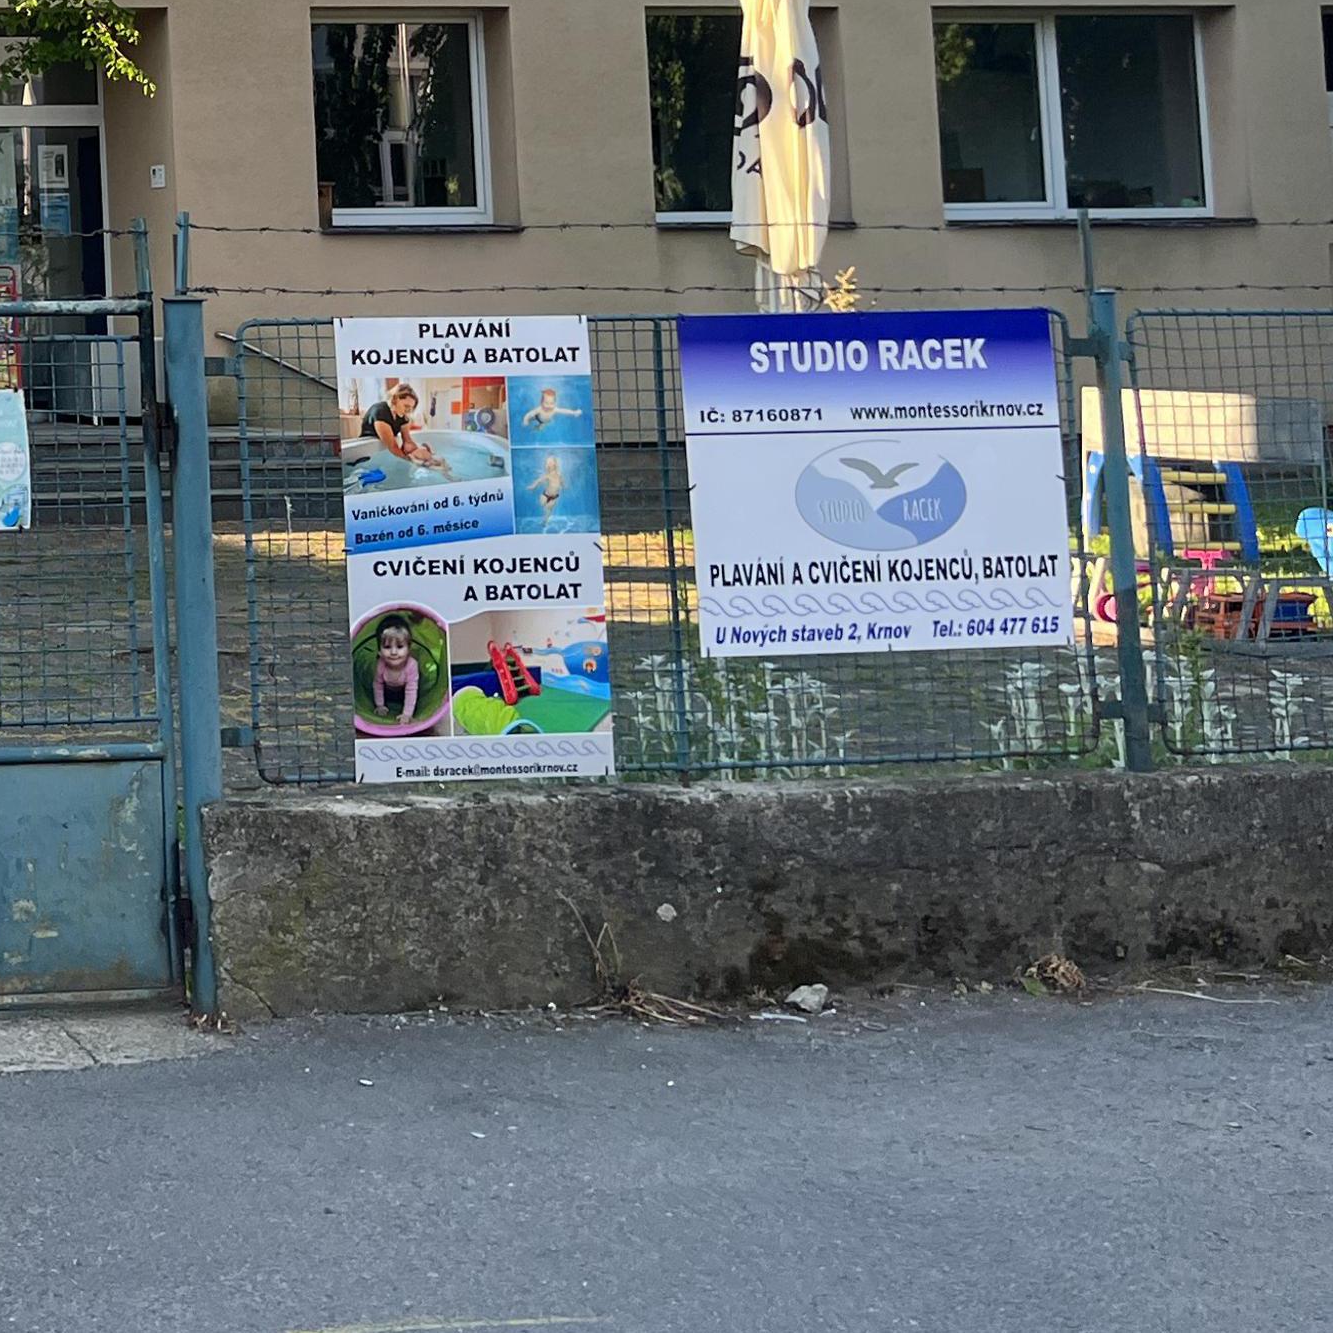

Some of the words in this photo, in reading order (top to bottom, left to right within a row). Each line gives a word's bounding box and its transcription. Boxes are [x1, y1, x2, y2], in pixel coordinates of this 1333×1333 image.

[418, 318, 511, 338] PLAVÁNÍ
[351, 343, 455, 365] KOJENCŮ
[462, 348, 477, 363] A
[485, 347, 580, 363] BATOLAT
[749, 340, 869, 374] STUDIO
[878, 338, 988, 370] RACEK
[699, 407, 725, 423] IČ:
[732, 408, 823, 423] 87160871
[850, 400, 1044, 420] www.montessorikrnov.cz
[433, 497, 449, 510] od
[452, 496, 465, 507] 6.
[468, 488, 504, 507] týdnů
[902, 497, 943, 522] RACEK
[355, 530, 394, 545] Bazén
[398, 526, 413, 539] od
[417, 524, 429, 536] 6.
[373, 554, 465, 576] CVIČENÍ
[474, 551, 579, 574] KOJENCŮ
[710, 555, 784, 587] PLAVÁNÍ
[792, 562, 803, 584] A
[808, 553, 881, 584] CVIČENÍ
[888, 548, 979, 585] KOJENCŮ,
[982, 554, 1058, 578] BATOLAT
[463, 586, 478, 601] A
[485, 583, 581, 601] BATOLAT
[716, 626, 726, 645] U
[731, 624, 787, 647] Nových
[791, 623, 843, 642] staveb
[848, 623, 861, 644] 2,
[866, 622, 911, 640] Krnov
[933, 619, 962, 638] Tel.:
[967, 618, 994, 636] 604
[999, 617, 1027, 635] 477
[1031, 616, 1059, 634] 615
